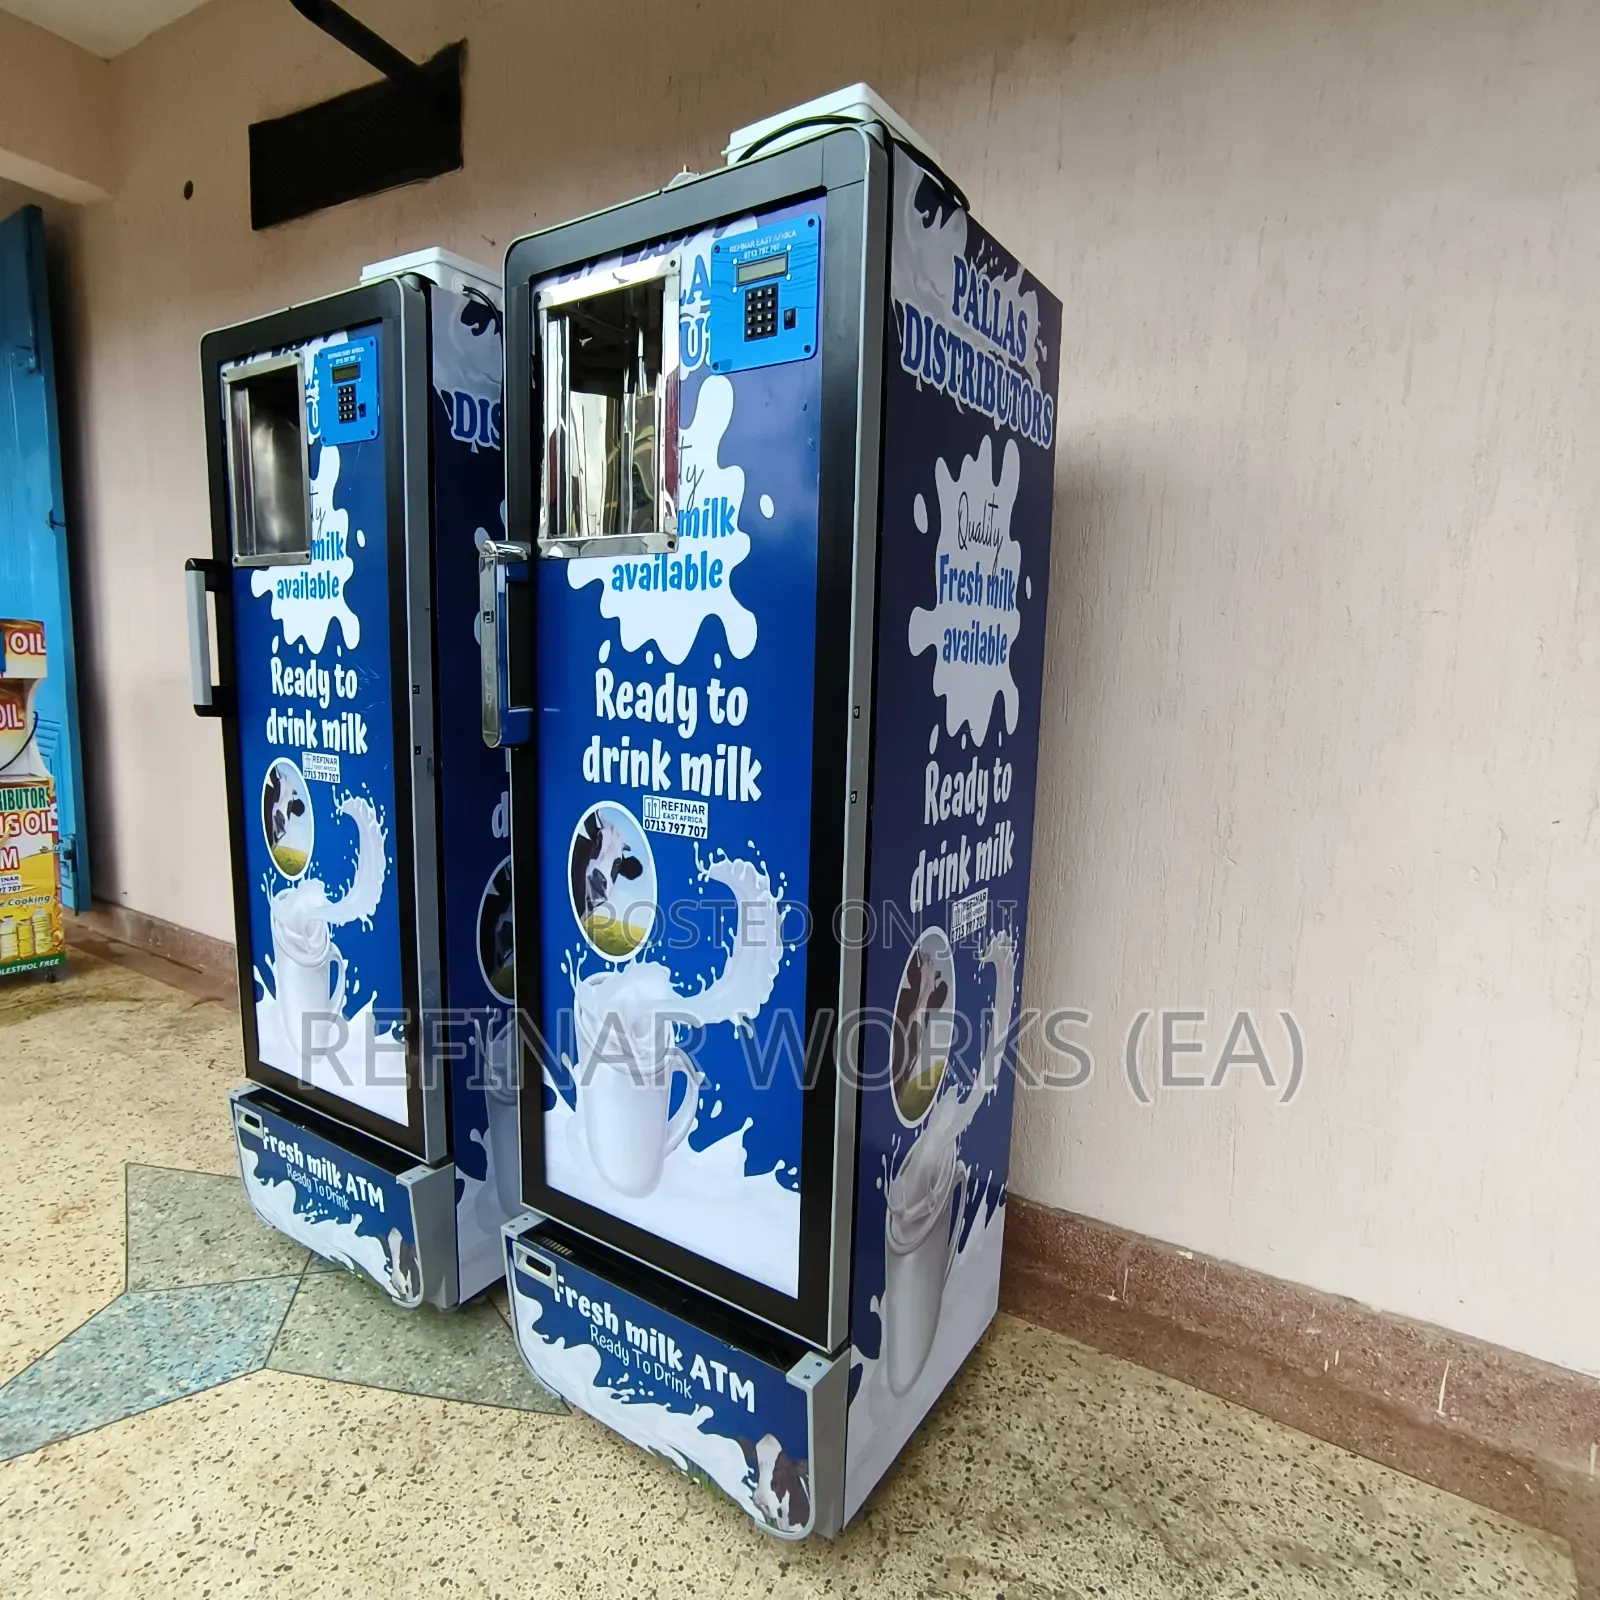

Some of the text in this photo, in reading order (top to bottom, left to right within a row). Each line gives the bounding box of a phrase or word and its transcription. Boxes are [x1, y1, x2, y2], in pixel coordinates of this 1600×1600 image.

[951, 254, 1028, 364] PALLAS
[901, 301, 1054, 448] DISTRIBUTORS
[957, 491, 1003, 577] Quality
[276, 571, 340, 600] available
[611, 552, 723, 593] available
[938, 554, 1016, 612] Fresh milk
[10, 631, 46, 654] OIL
[942, 619, 1008, 666] available
[270, 656, 358, 709] Ready to
[595, 667, 748, 739] Ready to
[266, 707, 368, 754] drink milk
[312, 755, 338, 766] REFINAR
[582, 735, 763, 802] drink milk
[661, 800, 705, 815] REFINAR
[924, 755, 1012, 826] Ready to
[24, 811, 58, 833] OIL
[644, 818, 706, 838] 0713 797 707
[663, 812, 703, 824] EAST AFRICA
[910, 819, 1014, 913] drink milk
[8, 894, 50, 906] Cooking
[39, 958, 60, 968] FREE
[286, 1162, 350, 1210] Ready To Drink
[307, 1154, 342, 1189] milk
[346, 1172, 385, 1213] ATM
[590, 1324, 692, 1399] Ready To Drink
[625, 1320, 683, 1371] milk
[690, 1354, 755, 1413] ATM
